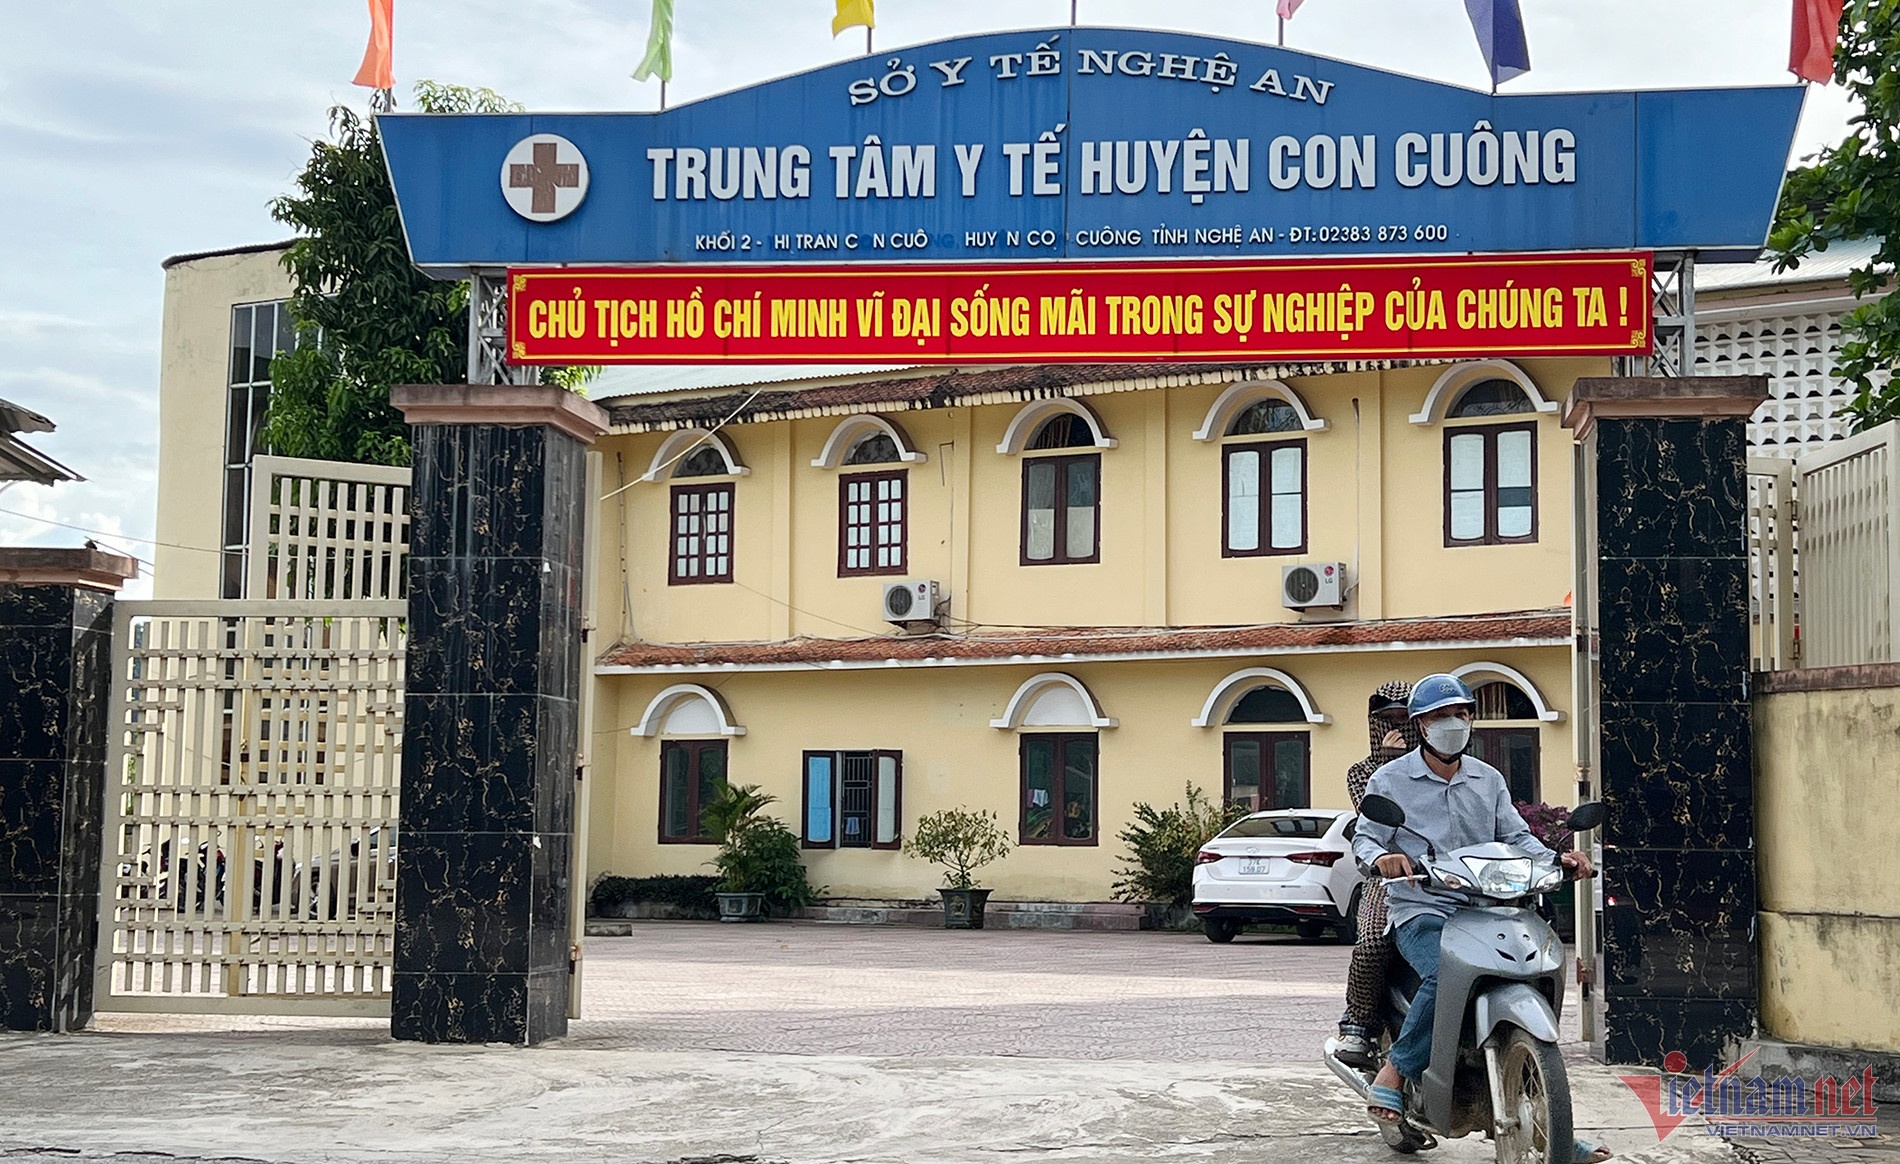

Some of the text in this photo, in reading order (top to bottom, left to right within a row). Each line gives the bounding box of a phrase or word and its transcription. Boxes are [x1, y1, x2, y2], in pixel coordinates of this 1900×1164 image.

[848, 34, 1335, 106] SỞ Y TẾ NGHỆ AN
[647, 120, 1576, 204] TRUNG TÂM Y TẾ HUYỆN CON CUÔNG
[695, 229, 736, 250] KHỐI
[741, 234, 751, 250] 2
[1075, 225, 1142, 246] CUÔNG
[1152, 223, 1188, 244] TỈNH
[1195, 224, 1242, 249] NGHỆ
[1249, 227, 1274, 244] AN
[1377, 225, 1408, 241] 873
[1414, 224, 1448, 241] 600
[529, 276, 1628, 347] CHỦ TỊCH HỒ CHÍ MINH VĨ ĐẠI SỐNG MÃI TRONG SỰ NGHIỆP CỦA CHÚNG TA !
[1324, 577, 1334, 585] LG
